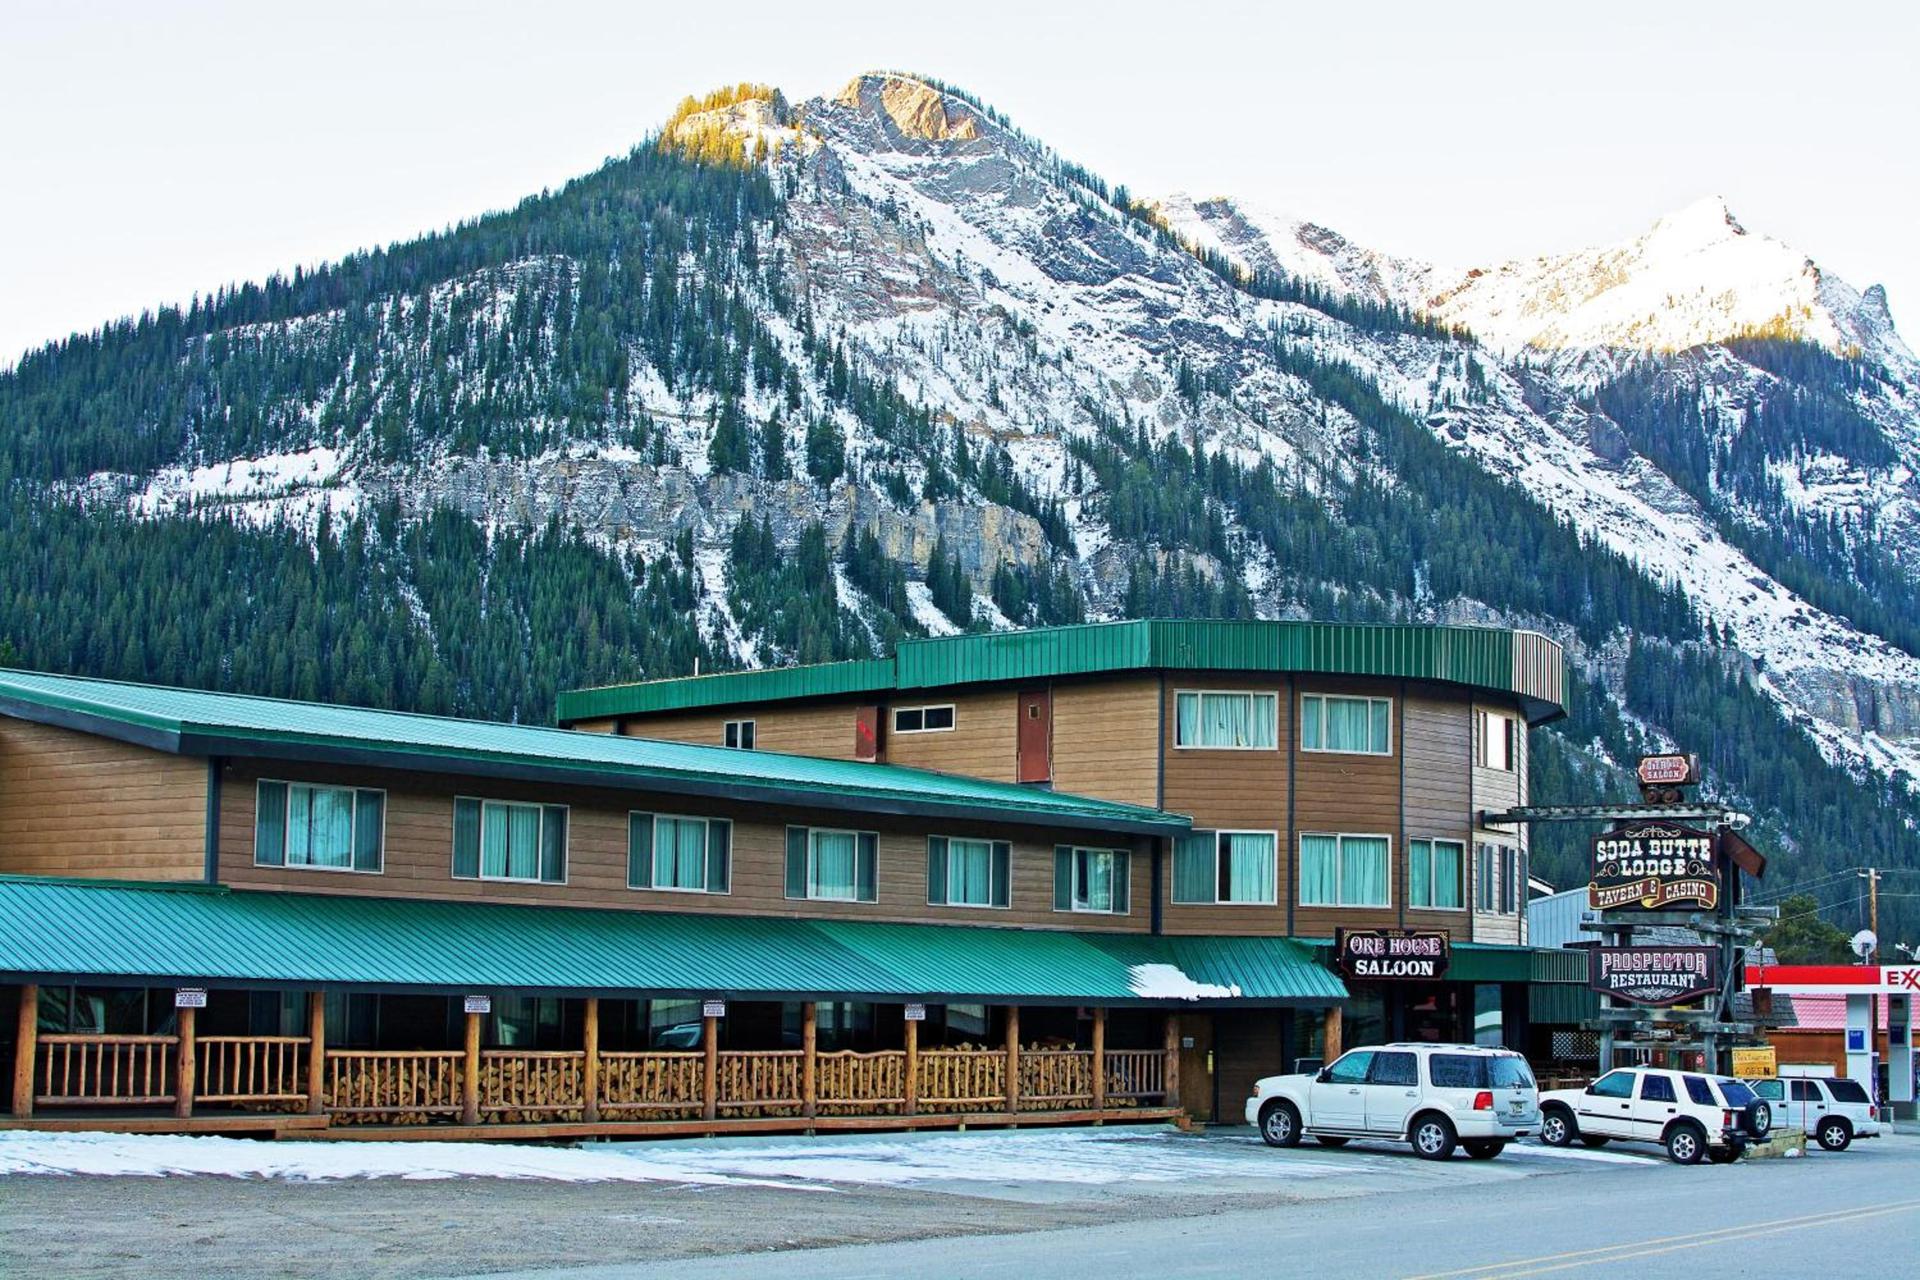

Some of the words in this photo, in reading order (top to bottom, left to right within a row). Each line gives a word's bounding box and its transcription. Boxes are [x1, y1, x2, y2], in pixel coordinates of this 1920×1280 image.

[1647, 770, 1680, 779] SALOON
[1596, 840, 1643, 862] SODA
[1648, 839, 1711, 862] BUTTE
[1620, 859, 1687, 877] LODGE
[1598, 883, 1643, 905] TAVERN
[1650, 880, 1657, 893] &
[1665, 883, 1706, 900] CASINO
[1349, 936, 1386, 957] ORE
[1389, 937, 1441, 956] HOUSE
[1355, 959, 1434, 976] SALOON
[1600, 952, 1708, 980] PROSPECTOR
[1610, 973, 1696, 989] RESTAURANT
